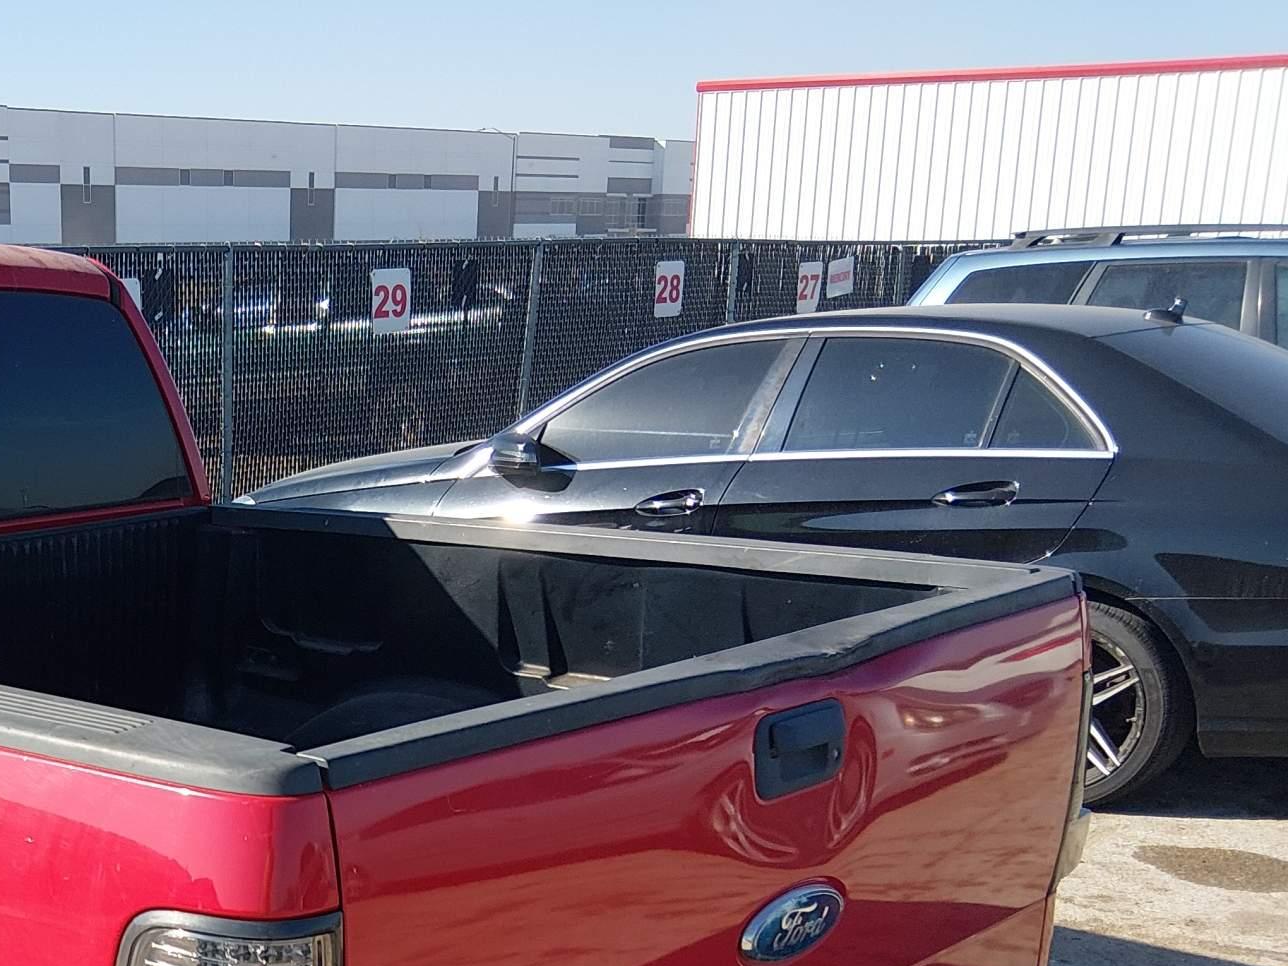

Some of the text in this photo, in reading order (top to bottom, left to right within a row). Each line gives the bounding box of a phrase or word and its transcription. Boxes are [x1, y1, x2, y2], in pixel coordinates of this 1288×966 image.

[373, 284, 407, 319] 29
[656, 274, 681, 304] 28
[798, 274, 820, 301] 27
[773, 902, 829, 952] Ford
